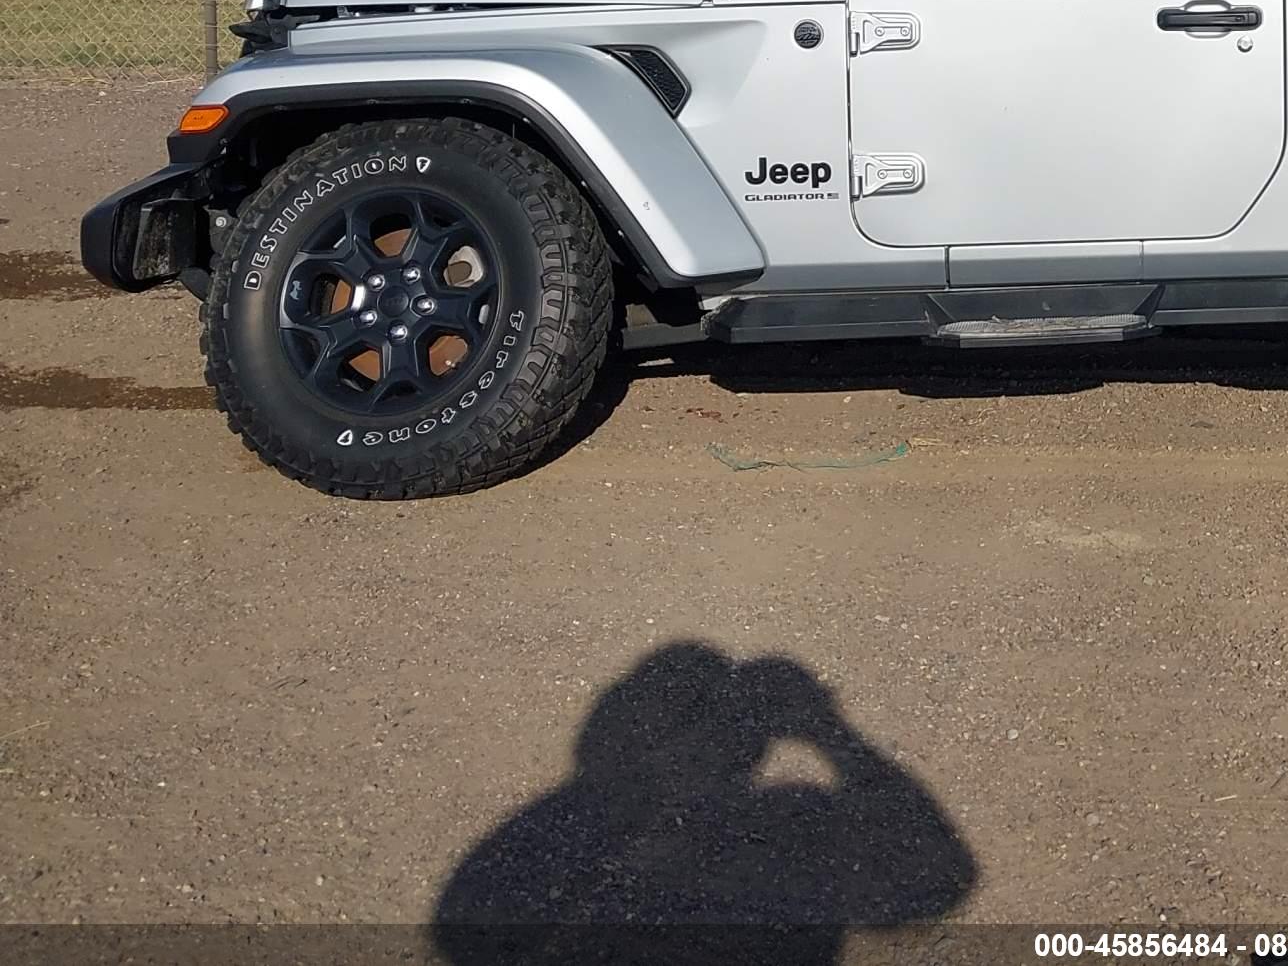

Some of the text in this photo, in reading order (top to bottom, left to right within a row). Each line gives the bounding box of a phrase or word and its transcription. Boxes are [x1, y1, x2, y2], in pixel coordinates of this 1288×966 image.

[744, 157, 832, 188] Jeep
[744, 193, 825, 202] GLADIATOR
[243, 155, 408, 291] DESTINATION
